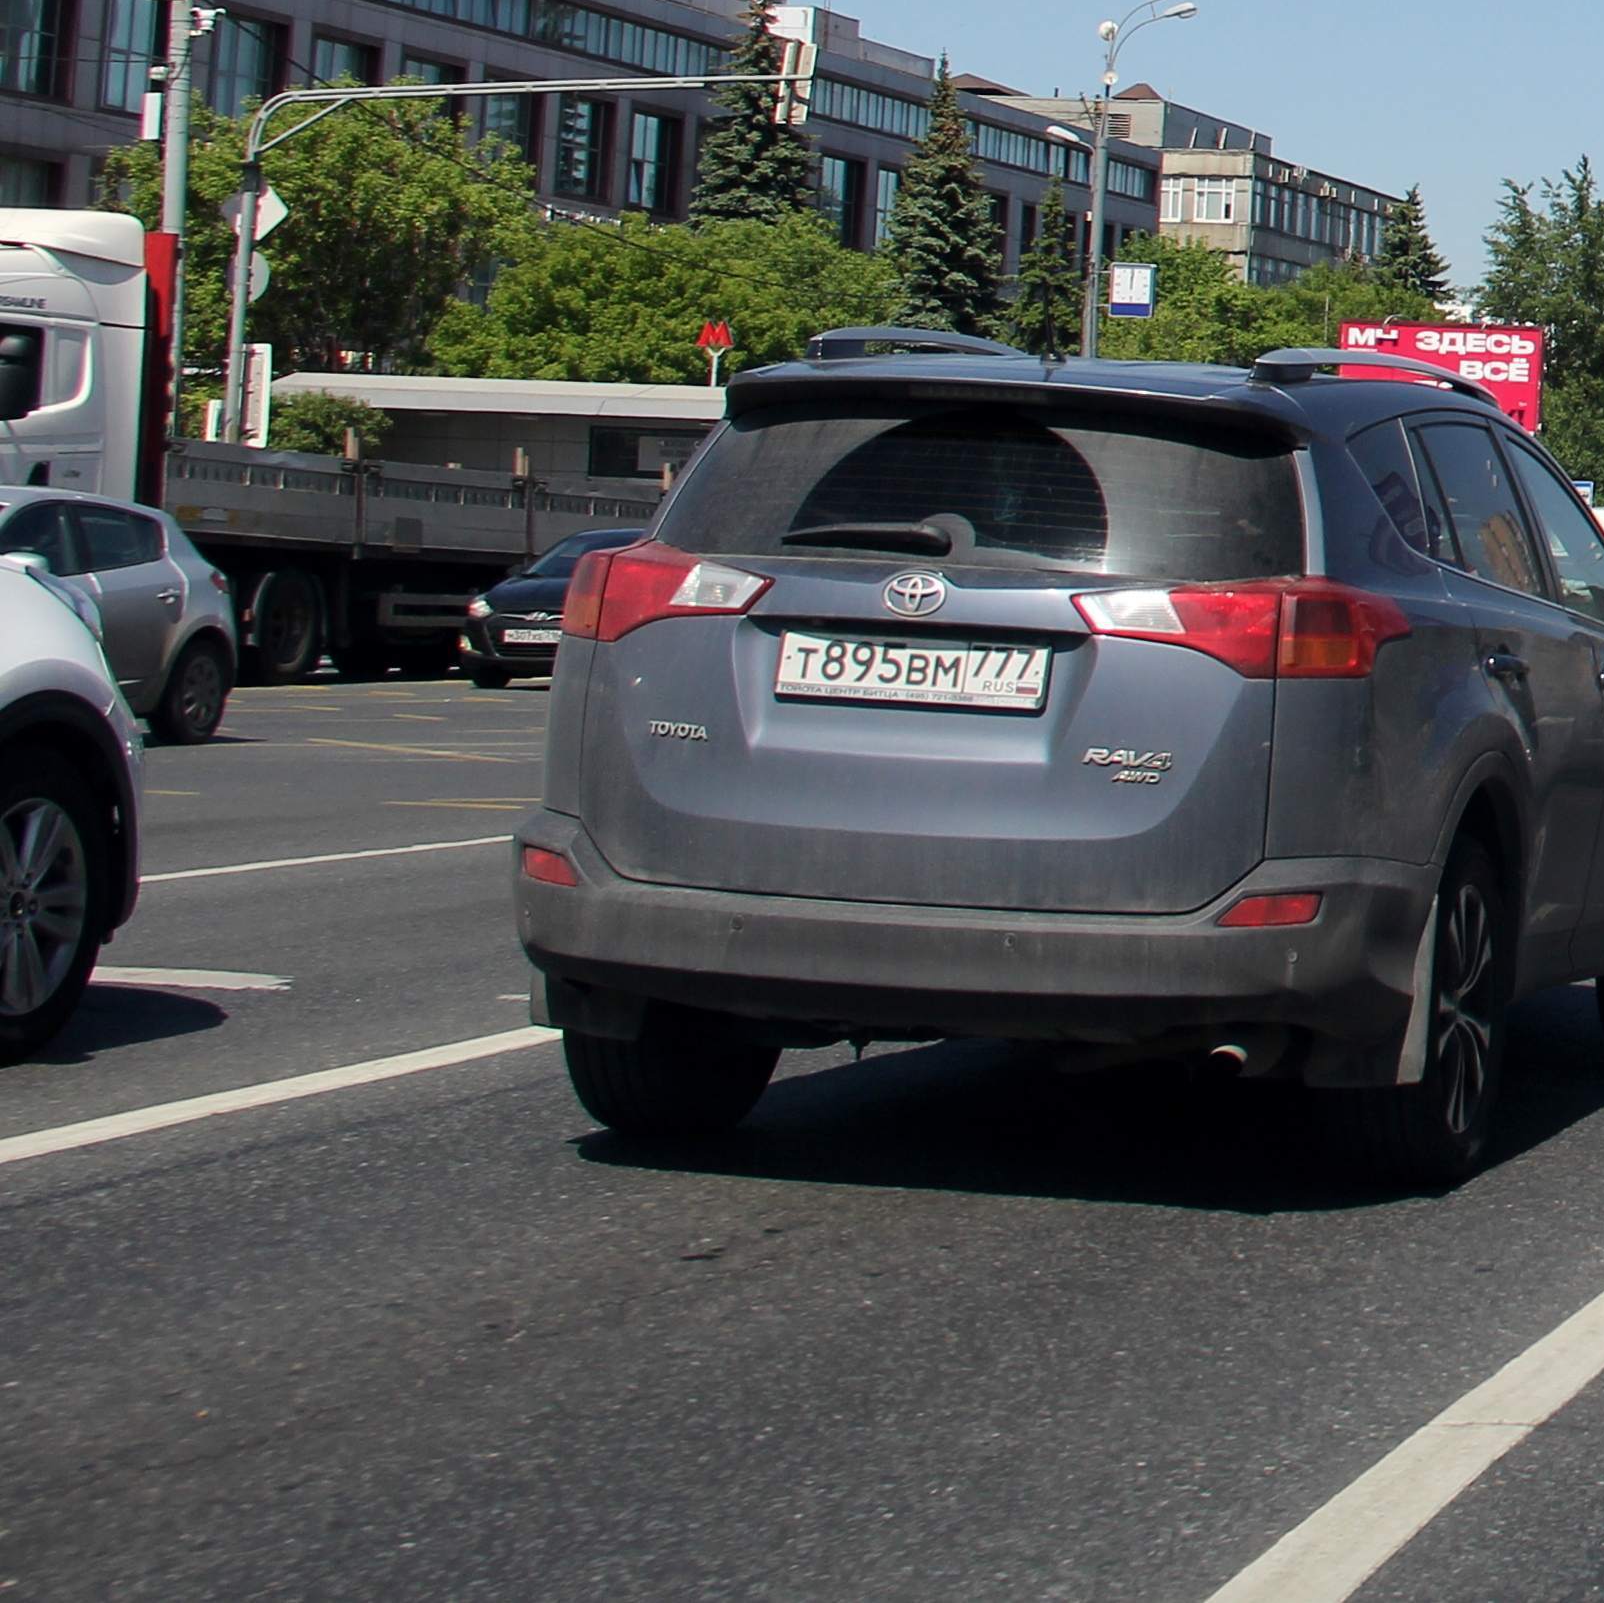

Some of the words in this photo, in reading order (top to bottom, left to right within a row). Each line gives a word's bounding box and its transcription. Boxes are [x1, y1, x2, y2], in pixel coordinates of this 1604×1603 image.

[1415, 331, 1535, 355] ЗДЕСЬ
[1459, 358, 1530, 382] ВСЁ
[797, 640, 962, 688] Т895ВМ
[972, 645, 1037, 681] 777
[982, 679, 1015, 694] RUS
[649, 719, 708, 742] TOYOTA
[1081, 747, 1172, 771] RAV4
